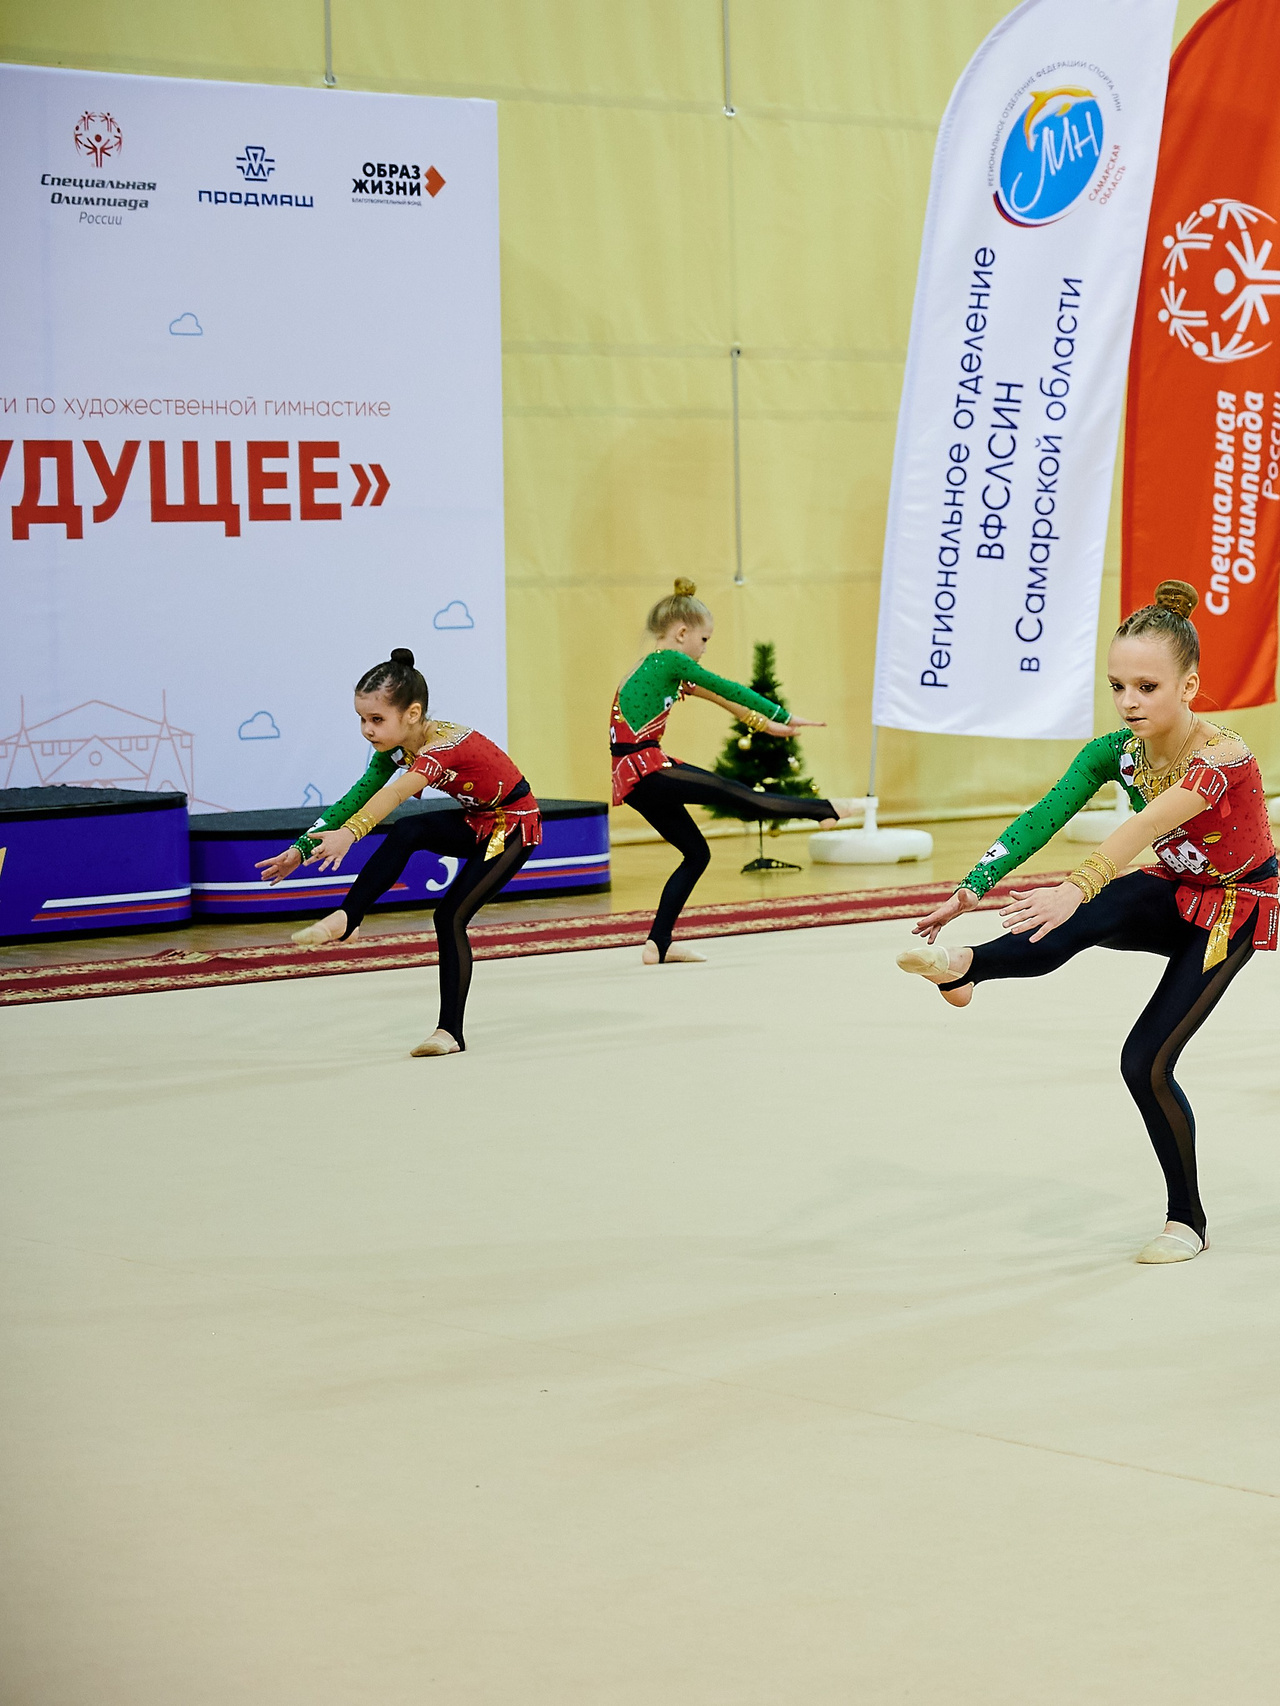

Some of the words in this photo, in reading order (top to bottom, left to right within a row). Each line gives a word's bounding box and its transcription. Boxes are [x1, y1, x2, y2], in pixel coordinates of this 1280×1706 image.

[1088, 64, 1114, 91] СПОРТА
[41, 174, 157, 191] Специальная
[352, 178, 421, 197] ЖИЗНИ
[362, 162, 421, 180] ОБРАЗ
[1088, 144, 1121, 201] САМАРСКАЯ
[1099, 165, 1126, 205] ОБЛАСТЬ
[51, 192, 149, 211] Олимпиада
[79, 211, 123, 226] России
[1040, 277, 1083, 421] области
[0, 398, 17, 413] и
[26, 398, 56, 414] по
[64, 396, 257, 420] художественной
[264, 399, 391, 417] гимнастике
[921, 442, 970, 688] Региональное
[954, 246, 996, 430] отделение
[977, 381, 1023, 560] ВФСЛСИН
[1205, 390, 1237, 615] Специальная
[1232, 390, 1264, 584] Олимпиада
[1015, 434, 1062, 642] Самарской
[1020, 656, 1040, 672] в
